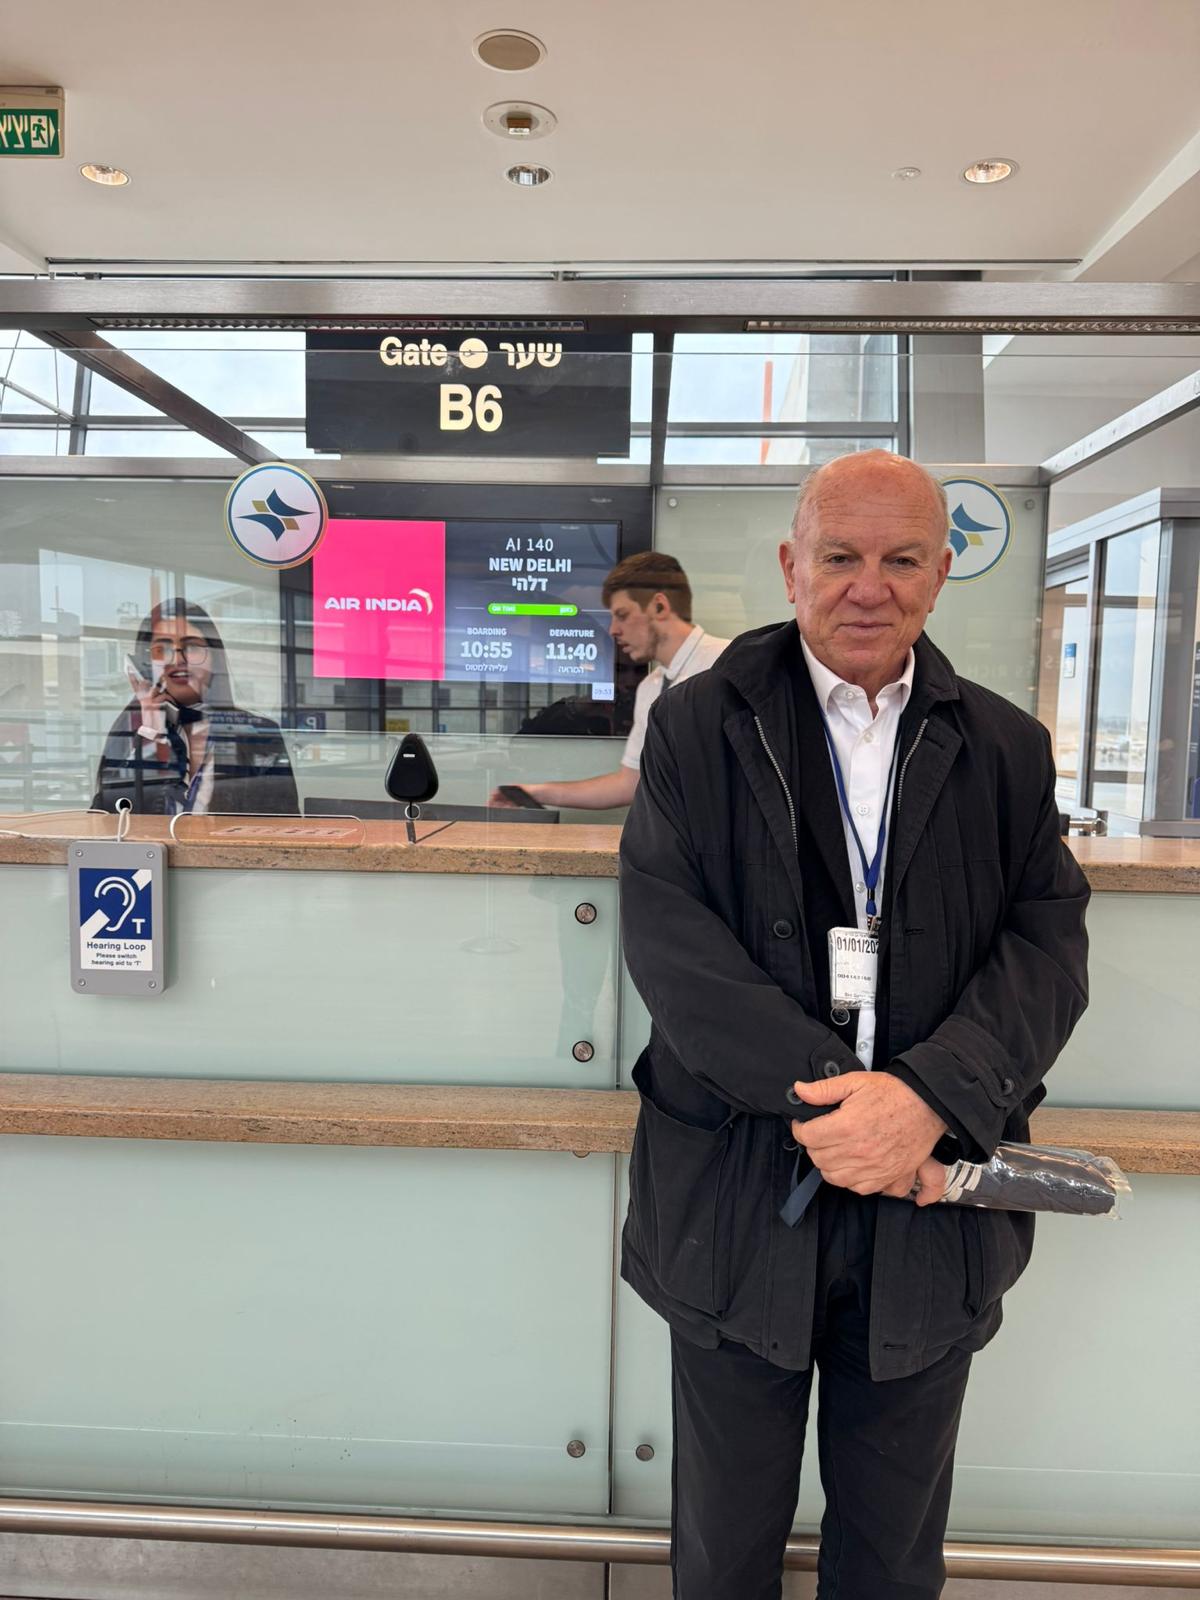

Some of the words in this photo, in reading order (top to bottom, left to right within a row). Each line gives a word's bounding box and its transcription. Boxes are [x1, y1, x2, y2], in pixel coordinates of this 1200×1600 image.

[379, 336, 448, 367] Gate
[499, 342, 563, 370] שער
[439, 383, 504, 433] B6
[505, 537, 521, 552] AI
[526, 538, 554, 552] 140
[488, 557, 524, 572] NEW
[526, 558, 572, 573] DELHI
[511, 574, 549, 592] דלהי
[324, 596, 361, 611] AIR
[365, 597, 422, 613] INDIA
[466, 627, 508, 637] BOARDING
[549, 628, 595, 638] DEPARTURE
[460, 640, 513, 659] 10:55
[545, 642, 598, 661] 11:40
[132, 918, 146, 934] T
[87, 941, 121, 951] Hearing
[123, 942, 146, 951] Loop
[91, 959, 114, 967] hearing
